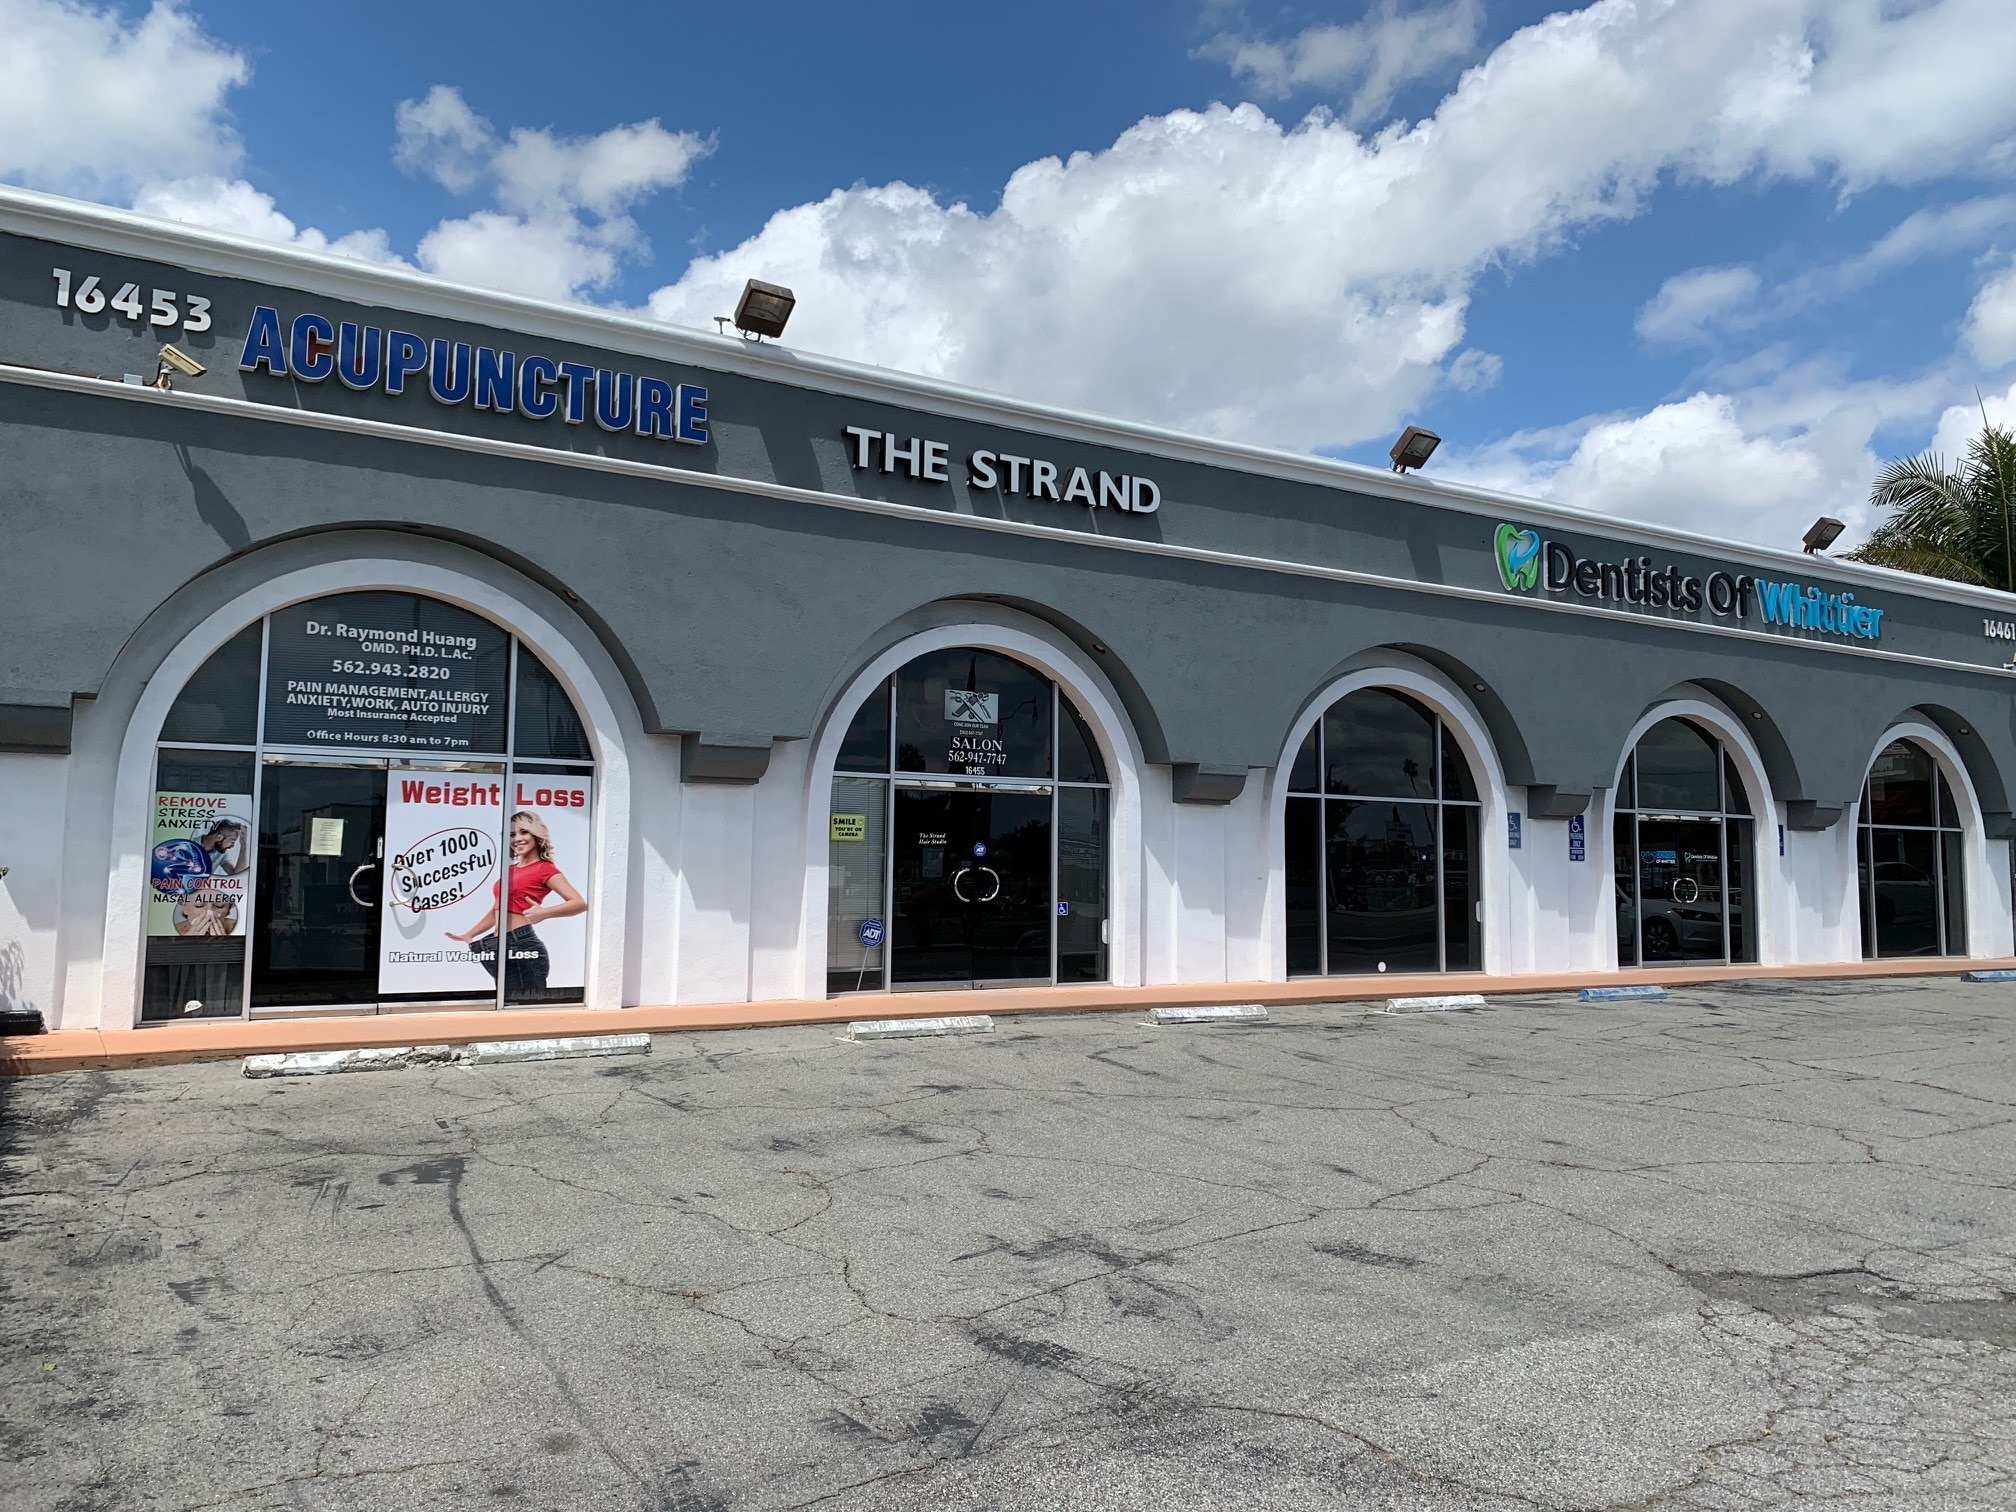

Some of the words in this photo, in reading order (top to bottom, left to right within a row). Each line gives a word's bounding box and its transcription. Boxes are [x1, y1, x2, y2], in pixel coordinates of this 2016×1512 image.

[52, 268, 212, 332] 16453
[239, 305, 709, 445] ACUPUNCTURE
[842, 425, 950, 482] THE
[968, 449, 1161, 514] STRAND
[1543, 540, 1701, 612] Dentists
[1706, 571, 1755, 619] Of
[1755, 578, 1884, 639] Whittier
[306, 621, 332, 636] Dr.
[336, 624, 418, 644] Raymond
[422, 631, 477, 650] Huang
[1982, 618, 2016, 641] 16461
[361, 642, 399, 655] OMD.
[402, 644, 439, 658] PH.D.
[441, 648, 472, 660] L.Ac.
[332, 659, 450, 680] 562.943.2820
[287, 680, 322, 694] PAIN
[401, 700, 439, 713] AUTO
[442, 702, 489, 715] INJURY
[327, 708, 354, 719] Most
[356, 709, 407, 721] Insurance
[410, 714, 457, 724] Accepted
[307, 729, 341, 741] Office
[344, 731, 379, 743] Hours
[382, 734, 407, 744] 8:30
[409, 736, 427, 745] am
[429, 736, 441, 745] to
[444, 736, 469, 748] 7pm
[952, 736, 1003, 752] SALON
[948, 750, 1007, 765] 562-947-7747
[965, 765, 985, 776] 16455
[401, 780, 500, 806] Weight
[515, 783, 585, 807] Loss
[158, 796, 227, 809] REMOVE
[158, 808, 216, 819] STRESS
[833, 817, 856, 826] SMILE
[157, 818, 221, 831] ANXIETY
[393, 846, 435, 872] Over
[439, 830, 479, 857] 1000
[402, 848, 492, 893] Successful
[152, 877, 183, 889] PAIN
[186, 878, 243, 889] CONTROL
[153, 893, 191, 903] NASAL
[195, 894, 243, 904] ALLERGY
[411, 881, 465, 913] Cases!
[863, 928, 881, 940] ADT
[389, 950, 442, 963] Natural
[446, 950, 495, 963] Weight
[508, 949, 539, 960] Loss
